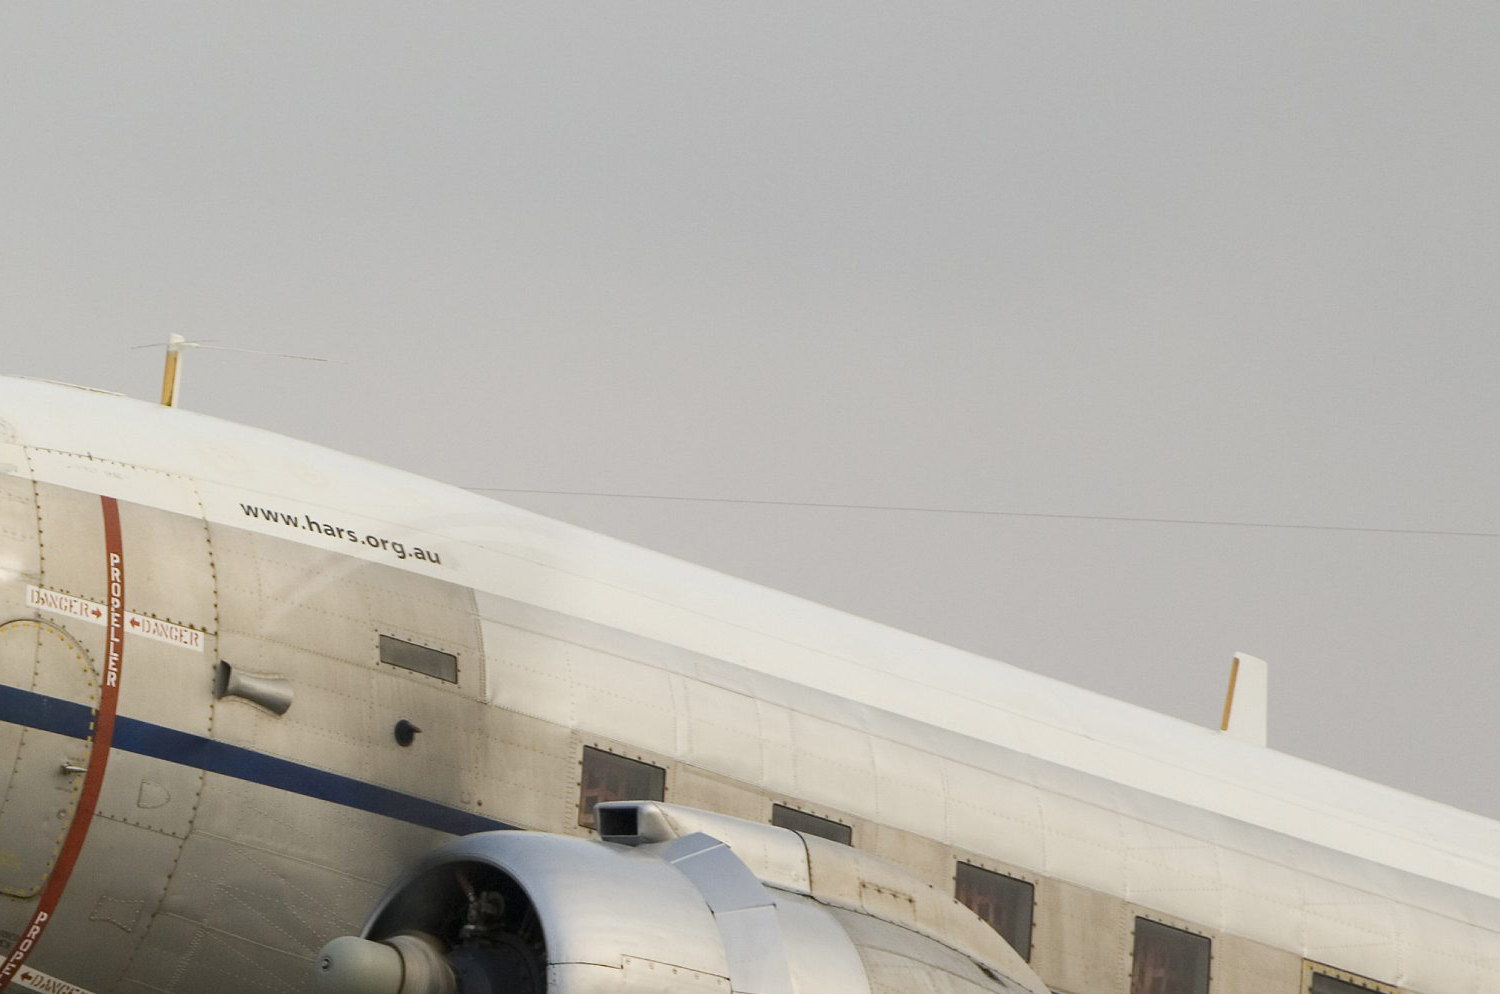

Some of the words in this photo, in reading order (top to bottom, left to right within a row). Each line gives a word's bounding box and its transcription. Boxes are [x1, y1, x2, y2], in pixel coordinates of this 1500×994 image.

[240, 501, 442, 566] www.hars.org.au
[30, 588, 90, 619] DANGER
[107, 552, 120, 688] PROPELLER
[140, 621, 201, 648] DANGER
